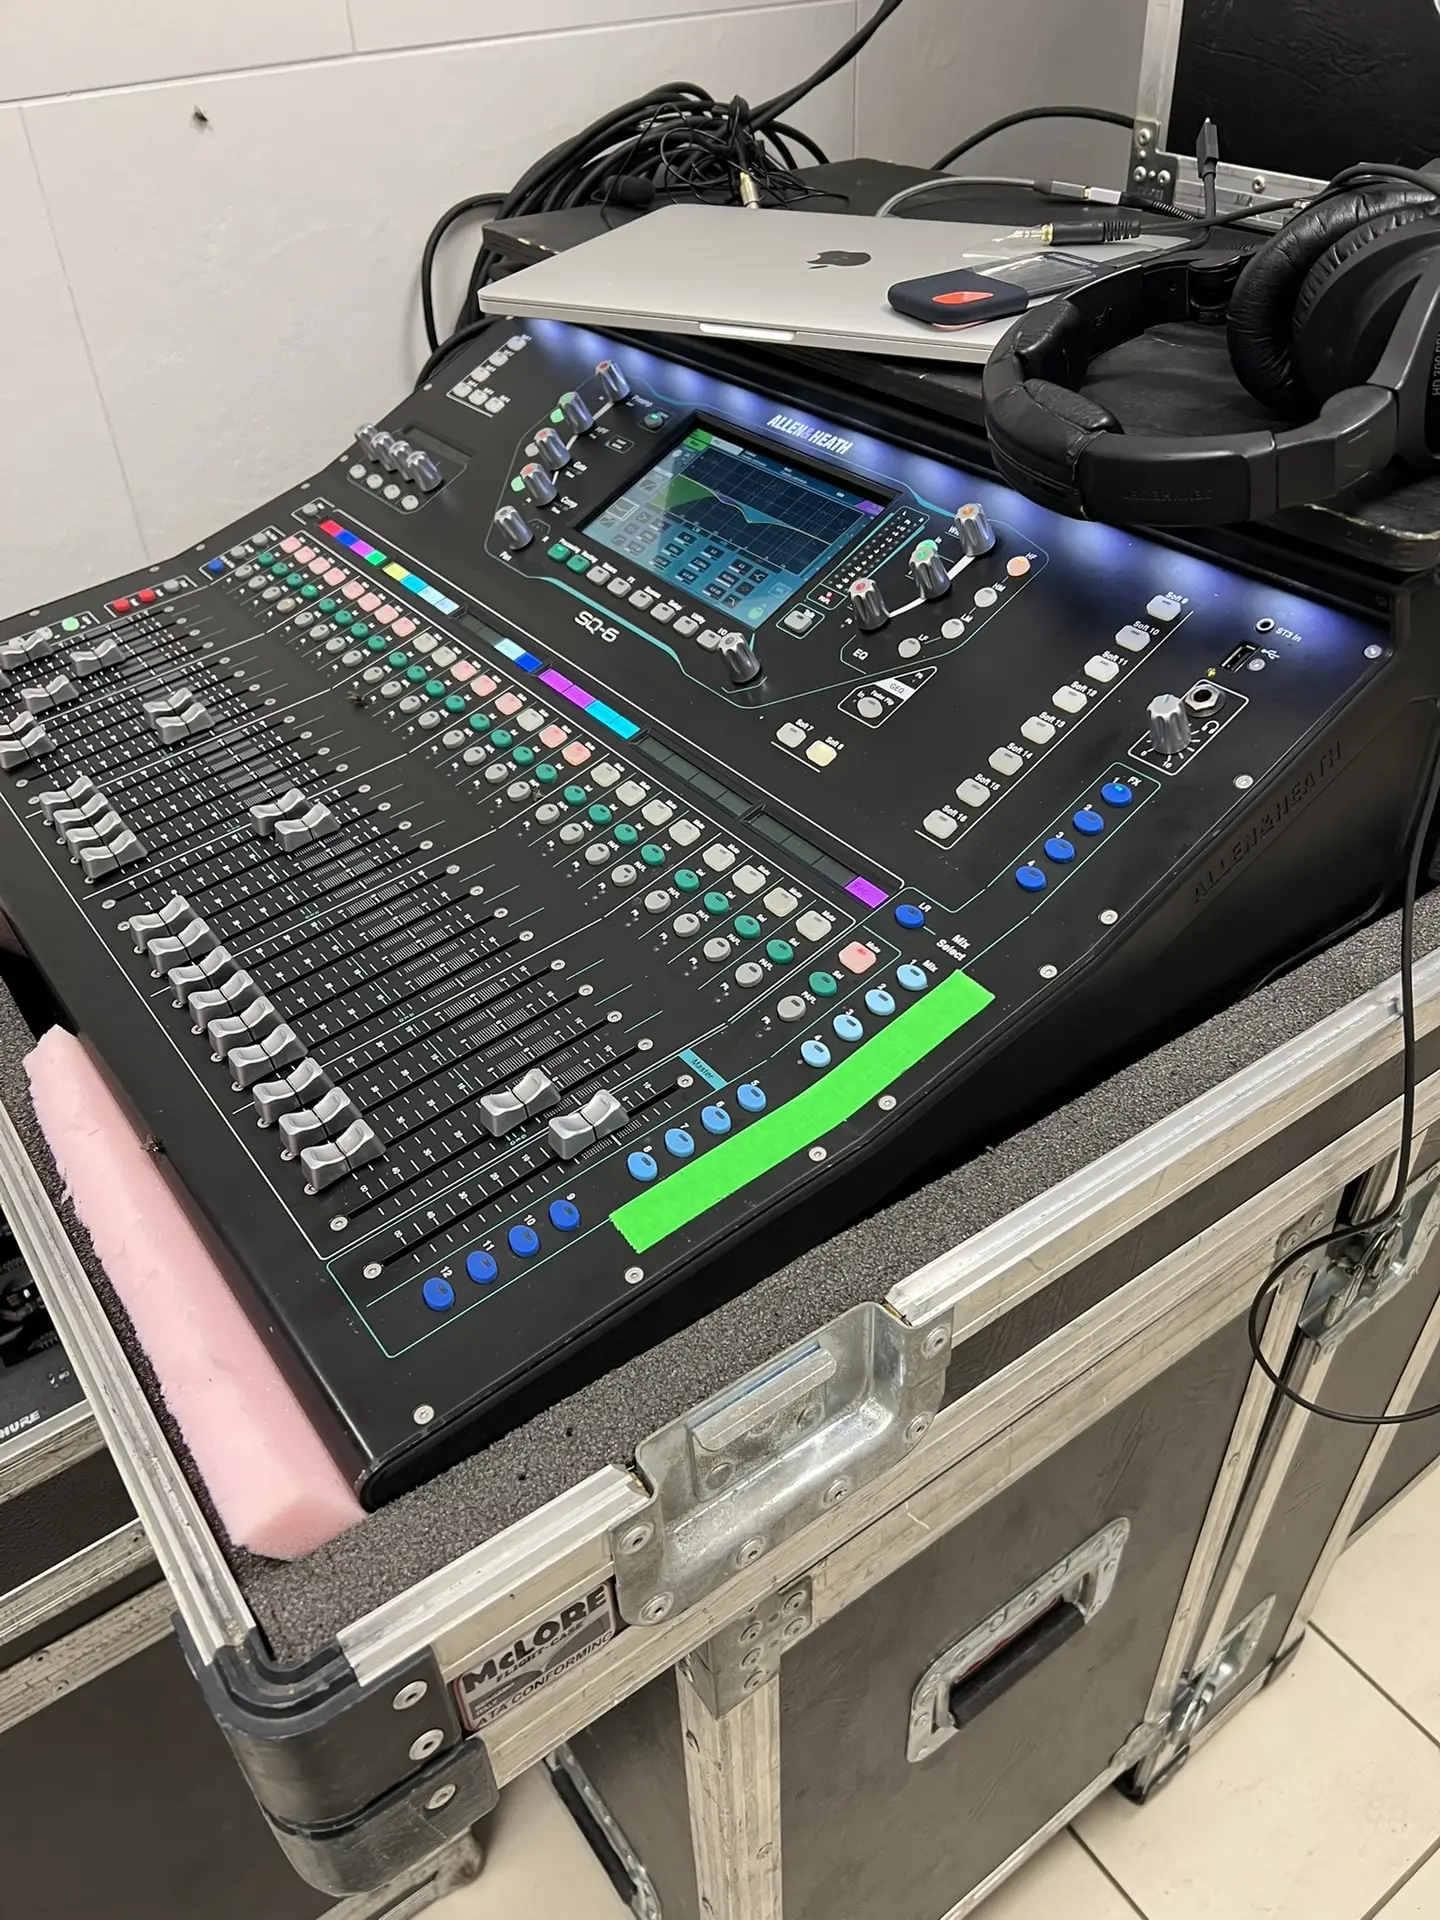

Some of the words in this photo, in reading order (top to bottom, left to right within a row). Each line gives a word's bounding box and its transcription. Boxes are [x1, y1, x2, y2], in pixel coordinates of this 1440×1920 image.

[766, 414, 853, 455] ALLEN&HEATH
[499, 551, 513, 562] Pan
[1025, 552, 1038, 562] HF
[993, 582, 1006, 592] HM
[1166, 591, 1183, 604] Soft
[961, 613, 974, 623] LM
[574, 610, 620, 643] SQ-6
[1132, 620, 1150, 632] Soft
[1149, 627, 1160, 636] 10
[918, 633, 929, 642] LF
[1275, 627, 1293, 639] ST3
[1292, 633, 1302, 643] In
[852, 648, 869, 661] EQ
[1101, 650, 1118, 663] Soft
[1117, 657, 1129, 666] 11
[889, 682, 905, 695] GEQ
[1070, 680, 1087, 693] Soft
[1086, 688, 1098, 697] 12
[795, 718, 810, 730] Soft
[1038, 711, 1055, 723] Soft
[1054, 719, 1066, 728] 13
[825, 736, 839, 748] Soft
[1006, 742, 1024, 755] Soft
[1022, 750, 1034, 760] 14
[1162, 760, 1173, 769] 10
[974, 773, 991, 786] Soft
[989, 781, 1001, 791] 15
[1127, 776, 1142, 787] FX
[1084, 803, 1093, 811] 2
[941, 804, 958, 817] Soft
[956, 813, 968, 823] 16
[1055, 831, 1064, 839] 3
[1027, 859, 1036, 867] 4
[918, 901, 932, 912] LR
[951, 933, 971, 950] Mix
[936, 938, 967, 962] Select
[922, 959, 938, 973] Mix
[878, 982, 887, 991] 2
[845, 1008, 854, 1016] 3
[691, 1058, 715, 1080] Master
[643, 1081, 651, 1089] 10
[751, 1079, 760, 1087] 5
[716, 1100, 725, 1108] 6
[680, 1121, 690, 1130] 7
[643, 1145, 653, 1153] 8
[521, 1153, 531, 1163] 10
[490, 1172, 500, 1181] 20
[458, 1191, 468, 1200] 30
[566, 1192, 576, 1201] 9
[426, 1210, 436, 1220] 40
[523, 1214, 536, 1226] 10
[482, 1239, 495, 1251] 11
[440, 1265, 453, 1279] 12
[0, 1410, 41, 1439] HURE
[461, 1585, 607, 1694] McLORE
[496, 1622, 584, 1683] FLIGHT-CASE
[476, 1703, 508, 1729] ATA
[511, 1630, 613, 1705] CONFORMING
